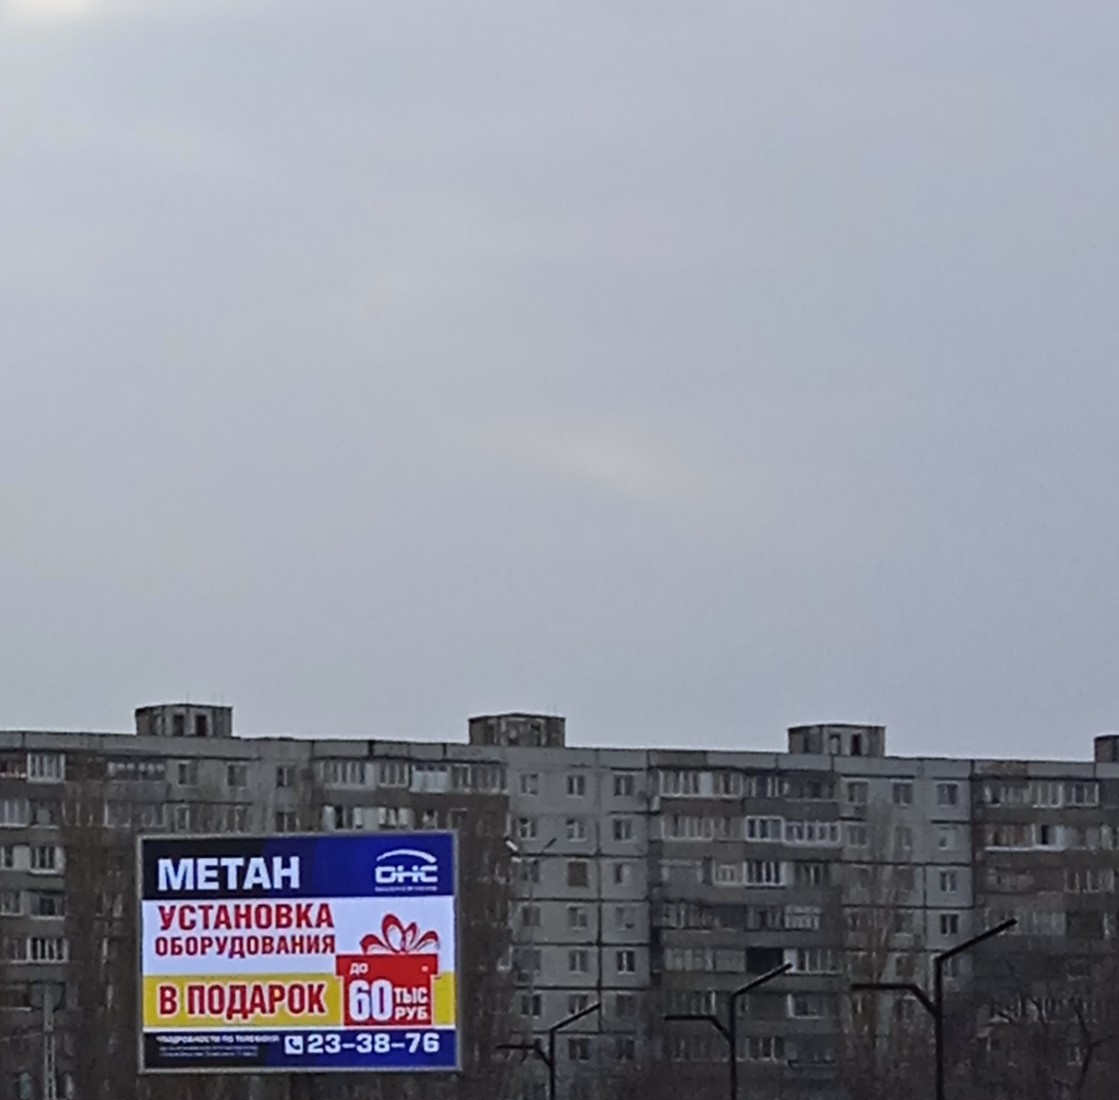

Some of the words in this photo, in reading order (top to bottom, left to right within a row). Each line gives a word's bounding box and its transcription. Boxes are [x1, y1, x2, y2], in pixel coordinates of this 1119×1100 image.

[157, 855, 300, 891] МЕТАН
[158, 903, 335, 931] УСТАНОВКА
[155, 934, 336, 959] ОБОРУДОВАНИЯ
[349, 962, 368, 976] ДО
[158, 984, 178, 1015] В
[186, 983, 326, 1020] ПОДАРОК
[348, 978, 393, 1021] 60
[307, 1032, 440, 1054] 23-38-76
